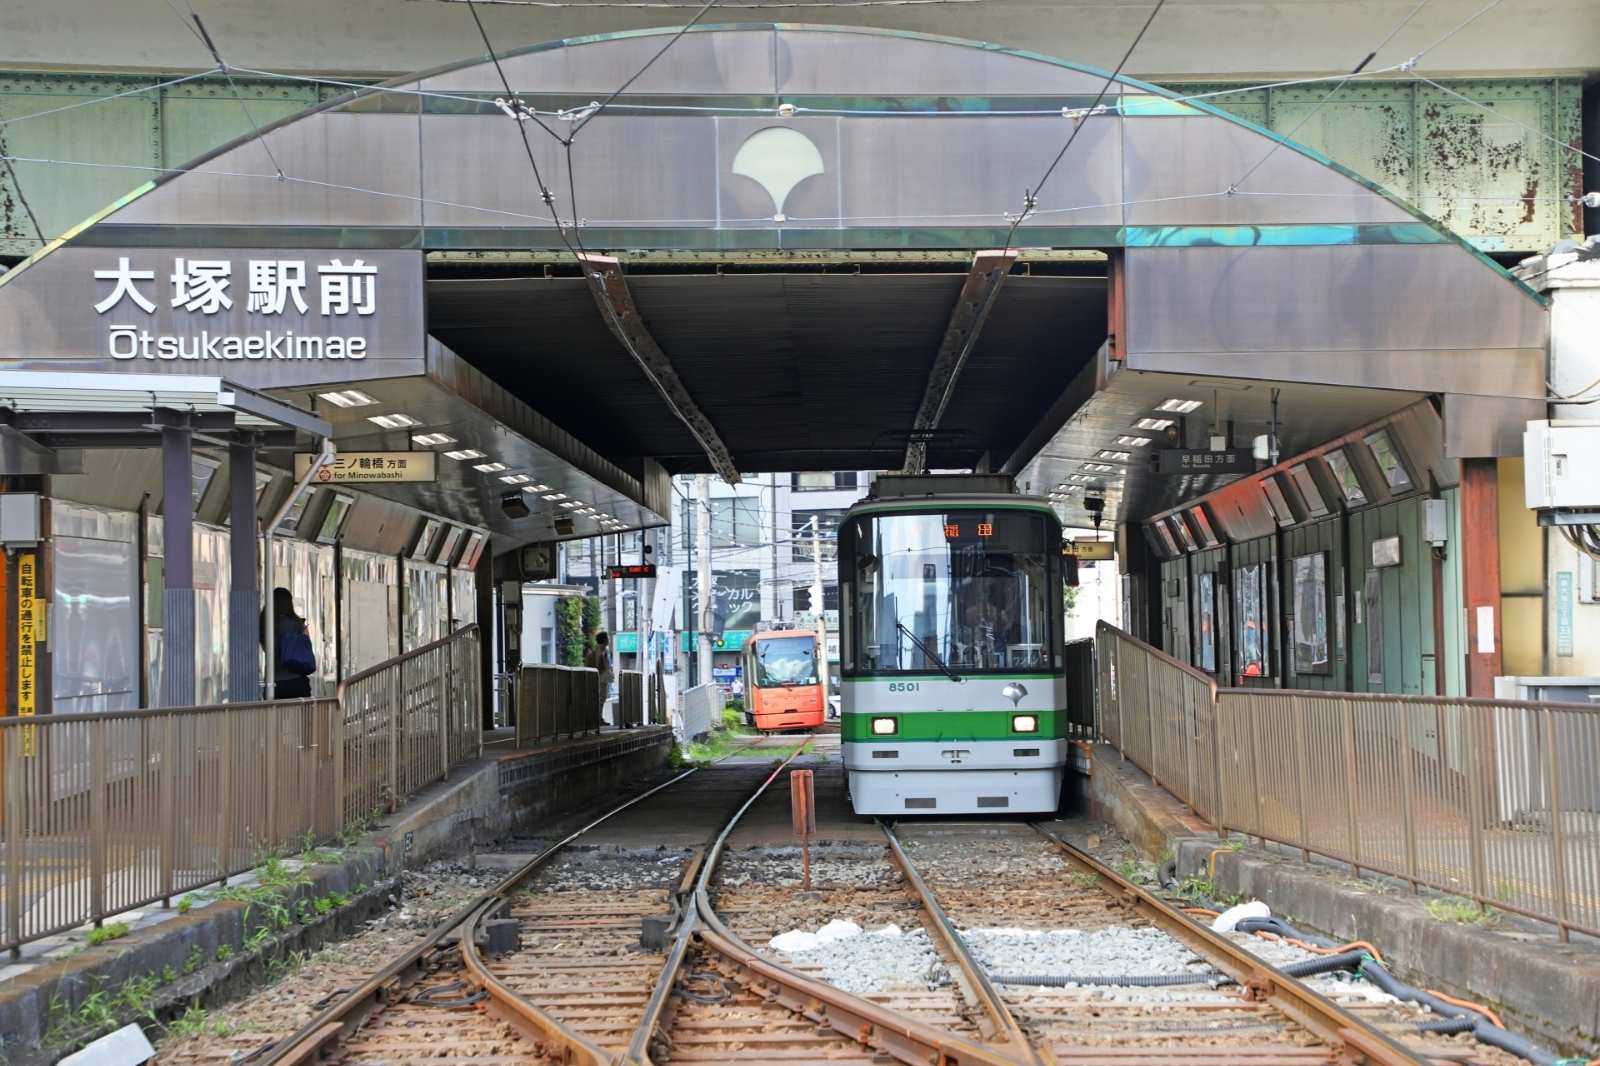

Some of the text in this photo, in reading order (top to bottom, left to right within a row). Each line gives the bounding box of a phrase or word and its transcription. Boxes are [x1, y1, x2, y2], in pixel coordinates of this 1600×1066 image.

[93, 256, 378, 316] 大塚駅前
[348, 471, 403, 479] Minowabashi
[20, 563, 33, 702] 自転車の通行を禁止します
[888, 682, 920, 692] 8501
